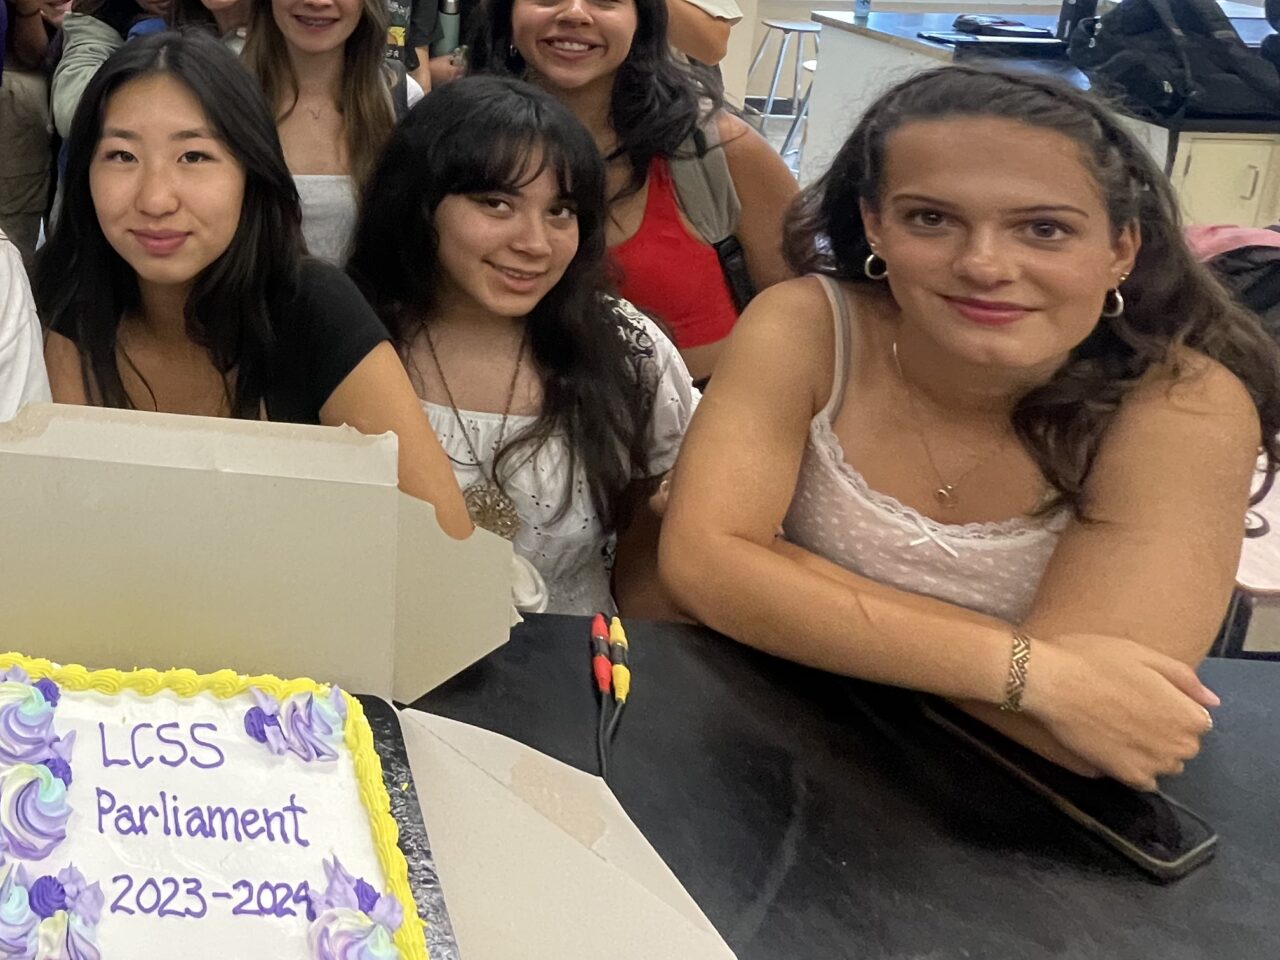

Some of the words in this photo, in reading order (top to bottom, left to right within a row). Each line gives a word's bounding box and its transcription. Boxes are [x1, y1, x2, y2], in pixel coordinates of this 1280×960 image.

[98, 721, 225, 769] LCSS
[95, 786, 310, 847] Parliament
[110, 873, 317, 922] 2023-2024
